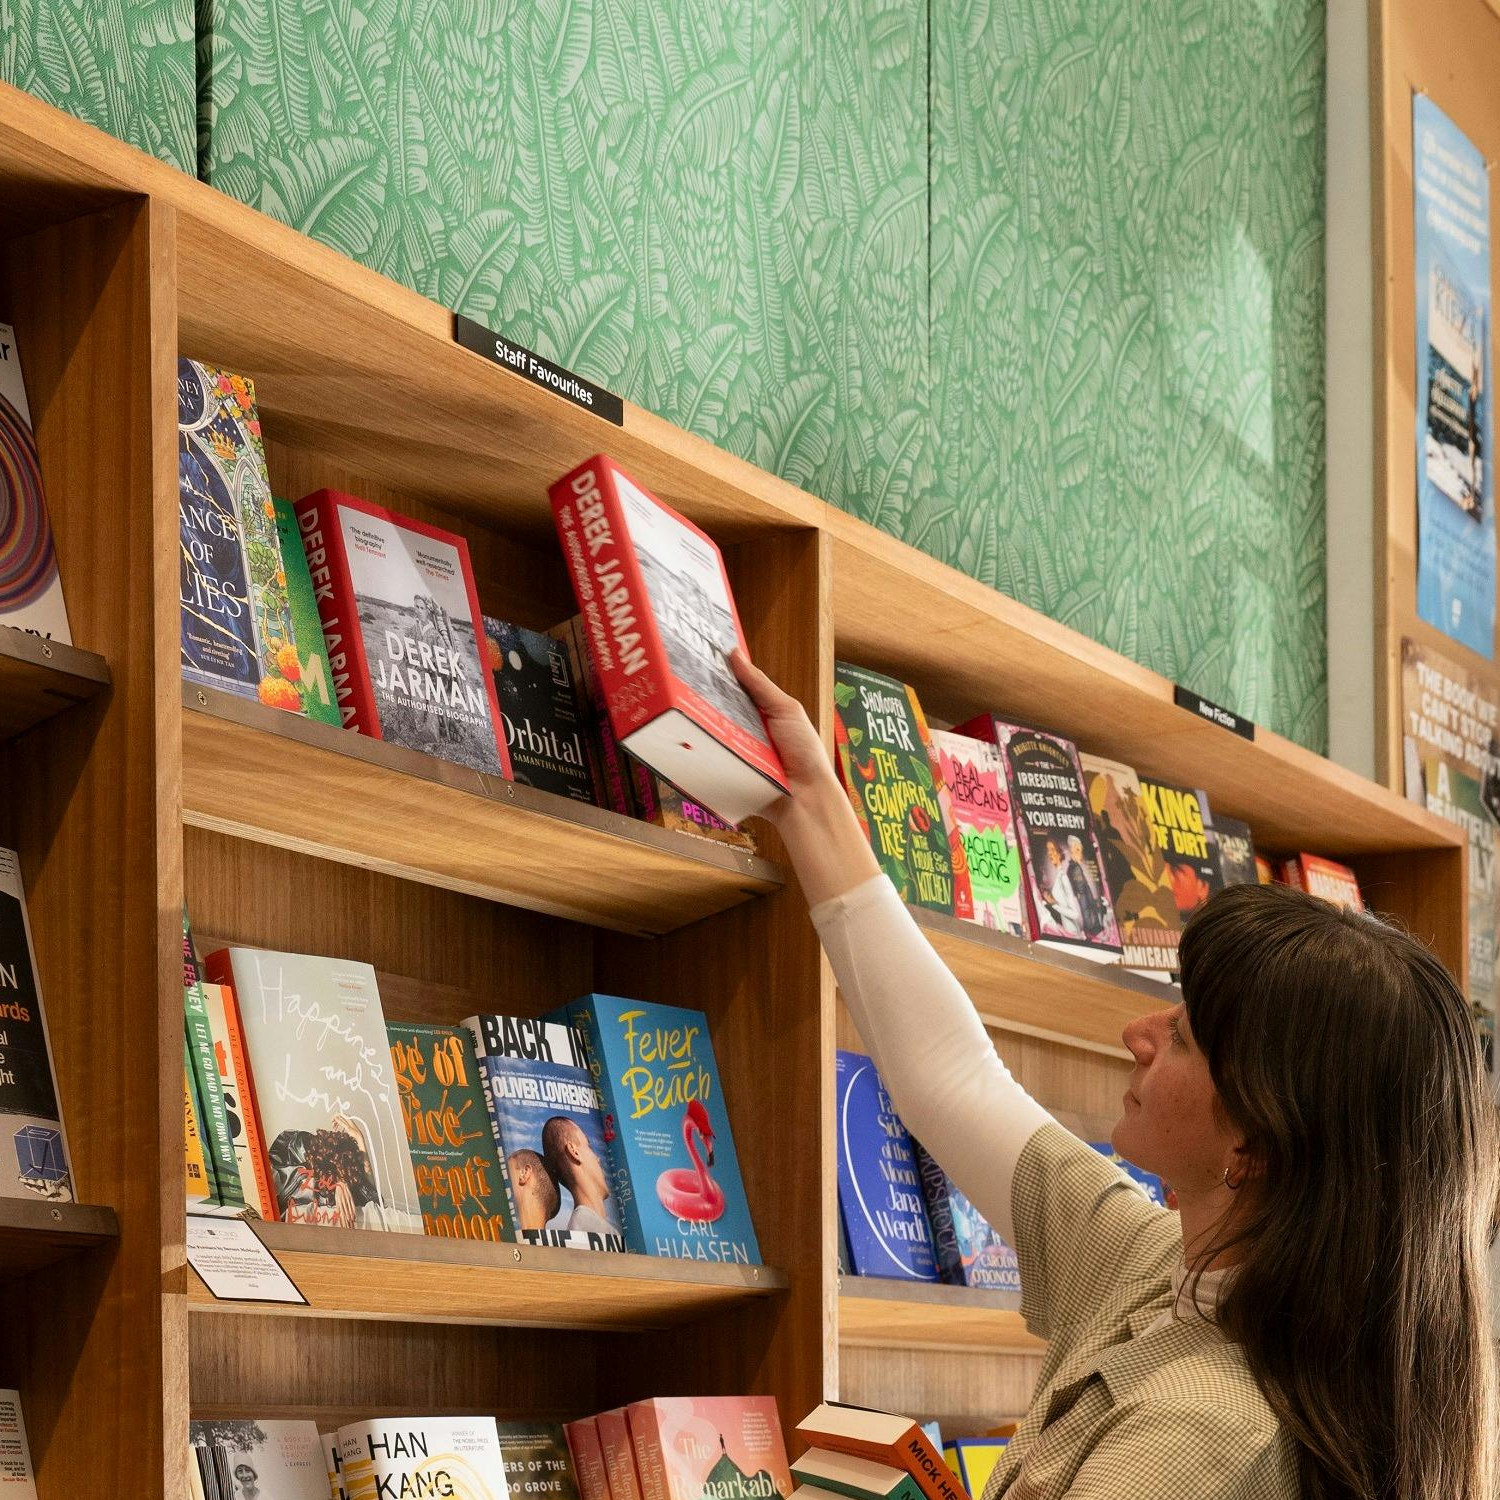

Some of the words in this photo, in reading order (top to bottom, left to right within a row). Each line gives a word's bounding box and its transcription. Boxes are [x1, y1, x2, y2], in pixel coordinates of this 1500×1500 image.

[495, 340, 527, 370] Staff
[529, 355, 594, 406] Favourites
[385, 630, 468, 681] DEREK
[376, 667, 486, 718] JARMAN
[399, 696, 445, 718] AUTHORISED
[445, 709, 488, 728] BIOGRAPHY
[1442, 676, 1477, 710] BOOK
[1198, 701, 1215, 718] New
[1215, 710, 1236, 729] Fiction
[1410, 711, 1462, 758] TALKING
[1421, 690, 1459, 728] CAN'T
[1462, 715, 1493, 747] STOP
[513, 752, 557, 771] SAMANTHA
[557, 763, 587, 780] HARVEY
[1017, 771, 1078, 793] IRRESISTIBLE
[1025, 809, 1054, 826] YOUR
[1054, 811, 1087, 831] ENEMY
[1147, 784, 1204, 828] KING
[873, 814, 906, 861] TREE
[481, 1015, 551, 1062] BACK
[618, 1010, 700, 1067] Fever
[492, 1076, 538, 1101] OLIVER
[538, 1079, 603, 1111] LOVRENSKI
[621, 1063, 711, 1121] Beach
[676, 1217, 718, 1239] CARL
[366, 1430, 429, 1462] HAN
[908, 1437, 945, 1481] MICK
